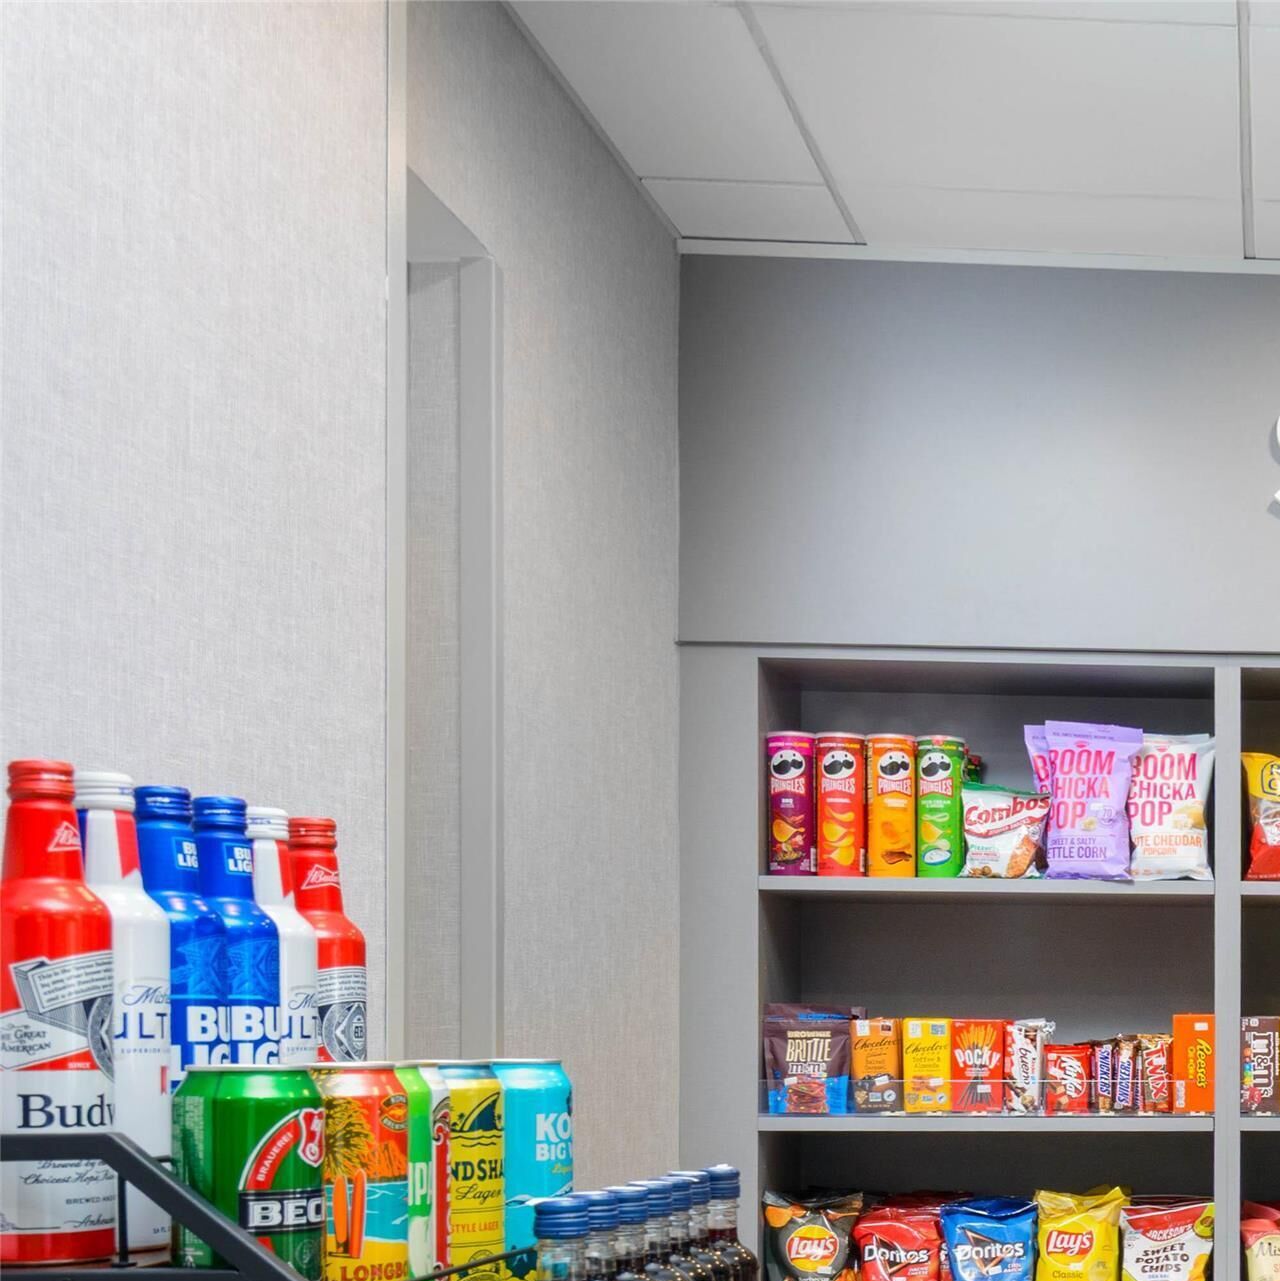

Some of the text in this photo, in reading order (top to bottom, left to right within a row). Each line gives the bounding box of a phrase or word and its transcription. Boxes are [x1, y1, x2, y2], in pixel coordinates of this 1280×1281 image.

[786, 1038, 832, 1061] BRITTLE
[256, 1131, 294, 1183] BRAUEREI
[790, 1237, 835, 1260] Lay's
[864, 1244, 930, 1263] Doritos
[1047, 1230, 1094, 1256] Lay's
[1142, 1243, 1185, 1257] SWEET
[1135, 1253, 1190, 1264] POTATO
[1141, 1263, 1182, 1273] CHIPS
